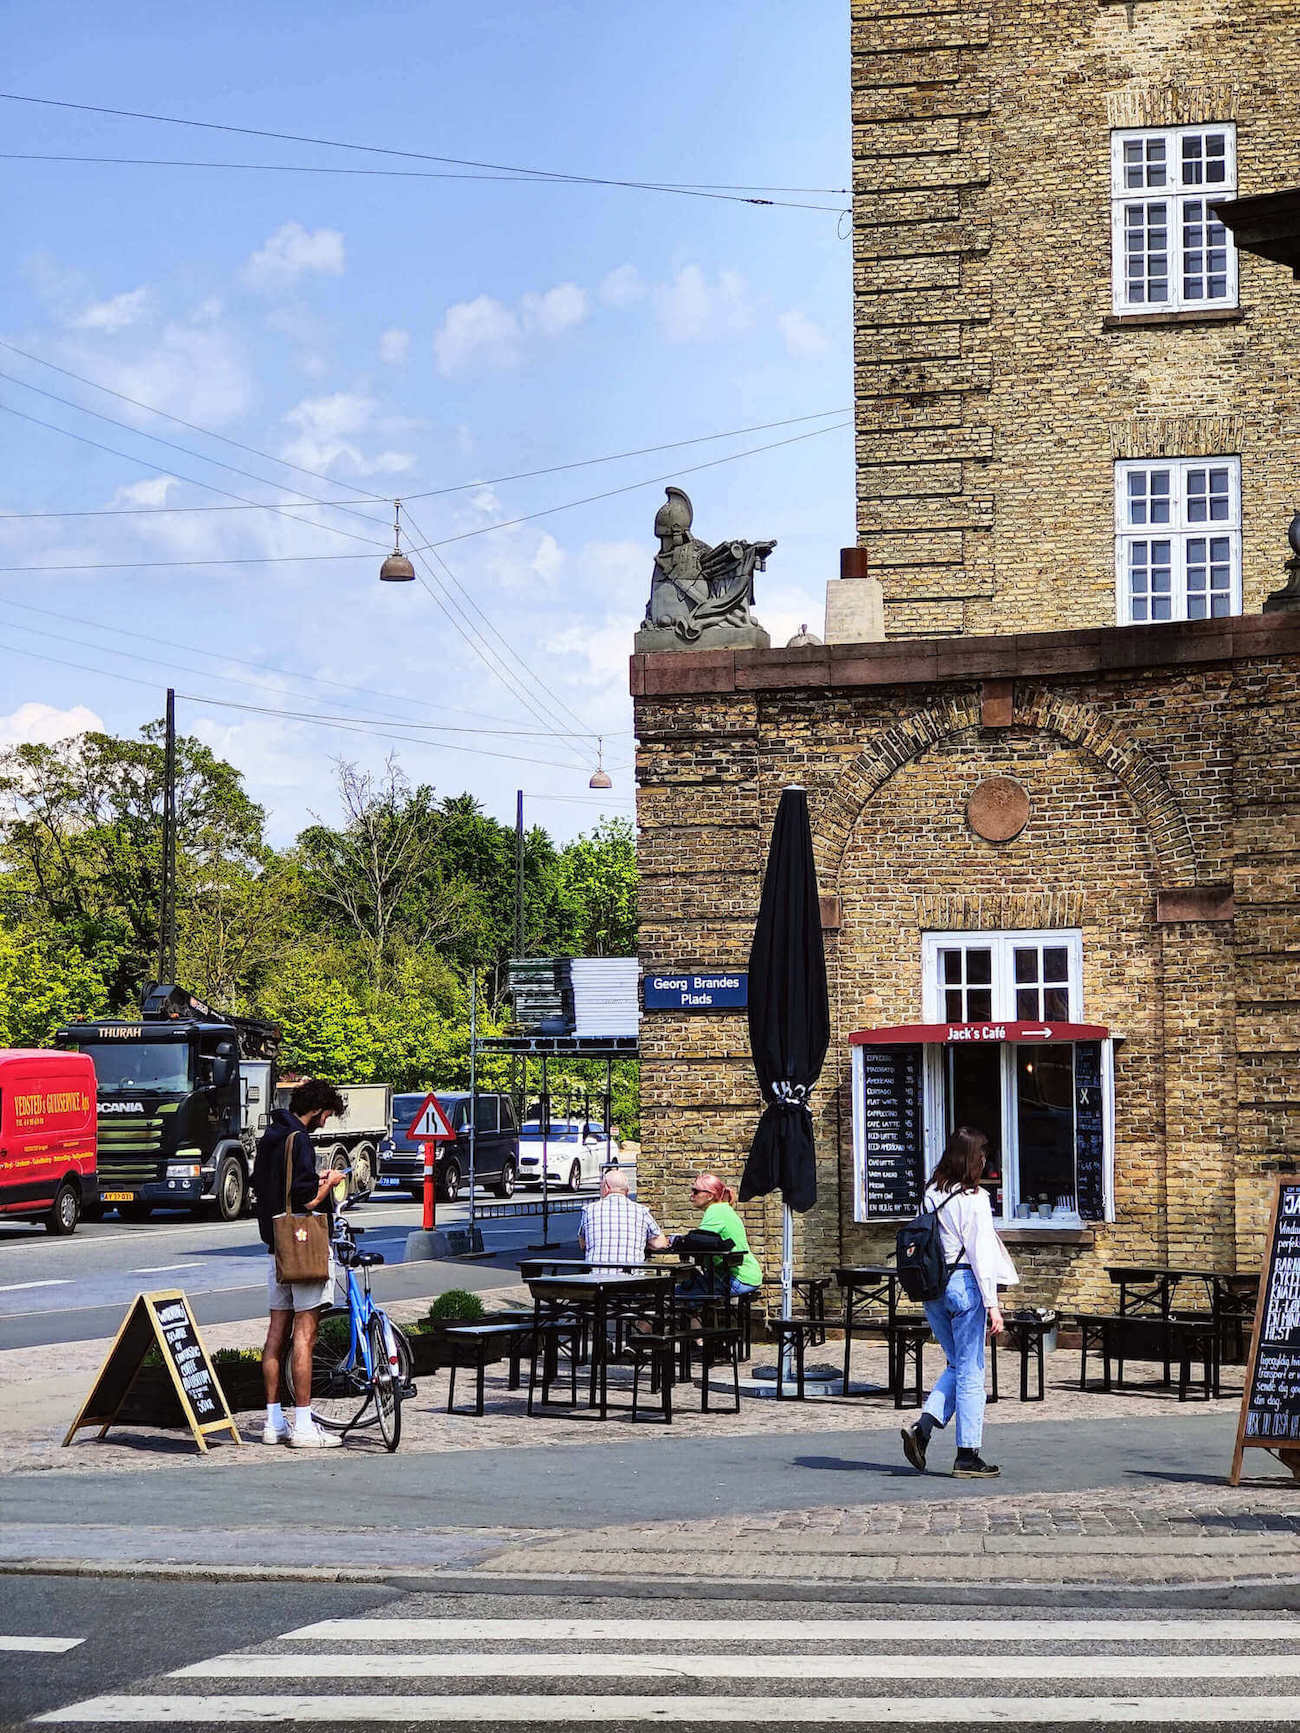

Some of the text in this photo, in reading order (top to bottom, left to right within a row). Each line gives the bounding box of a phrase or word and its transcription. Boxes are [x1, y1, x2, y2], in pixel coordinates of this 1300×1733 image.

[653, 976, 740, 991] Georg Brandes
[681, 993, 712, 1005] Plads
[98, 1027, 142, 1039] THURAH
[947, 1025, 1006, 1041] Jack's Café
